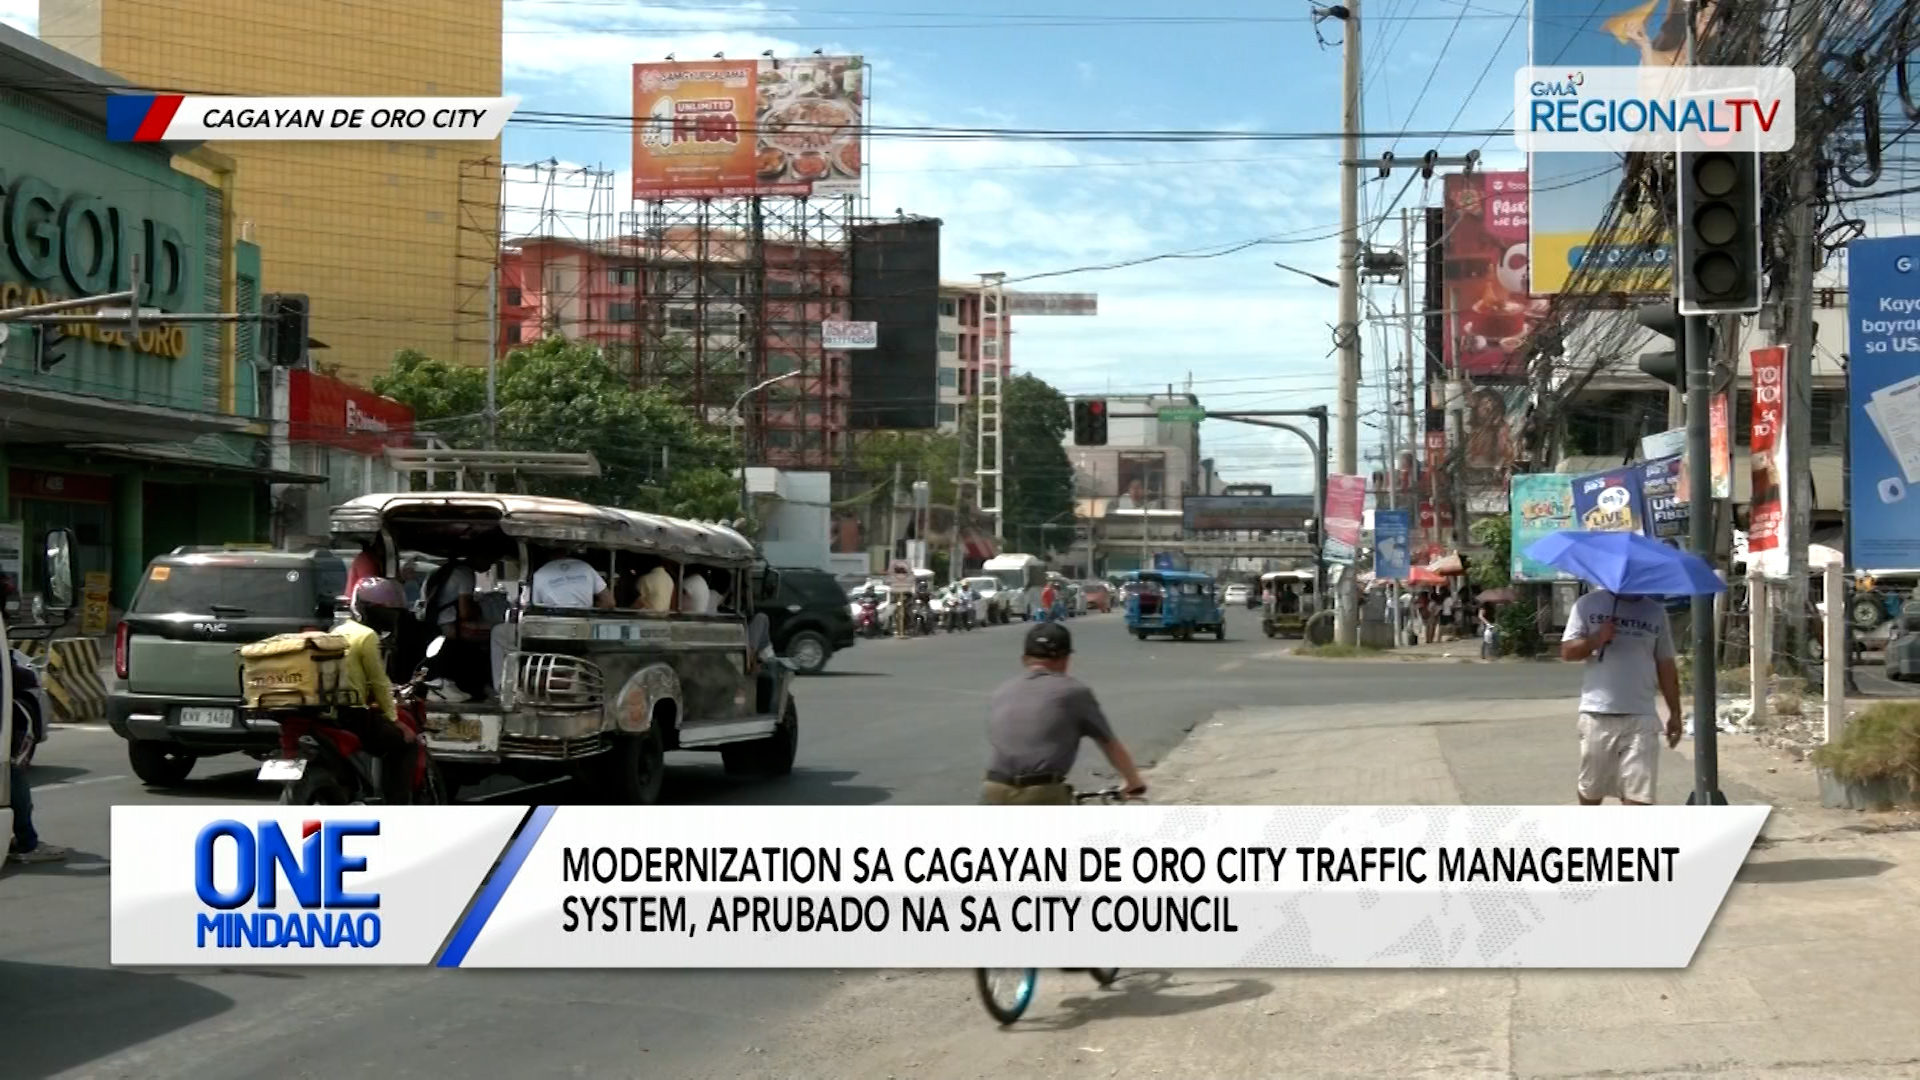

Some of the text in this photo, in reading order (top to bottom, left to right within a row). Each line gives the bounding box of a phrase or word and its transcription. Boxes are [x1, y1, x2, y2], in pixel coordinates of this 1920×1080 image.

[677, 100, 732, 112] UNLIMITED
[0, 175, 187, 312] GOLD
[1861, 319, 1920, 336] bayra
[137, 318, 187, 359] ORO
[1865, 336, 1920, 354] sa US
[1592, 510, 1623, 527] LIVE
[251, 669, 303, 686] maxim
